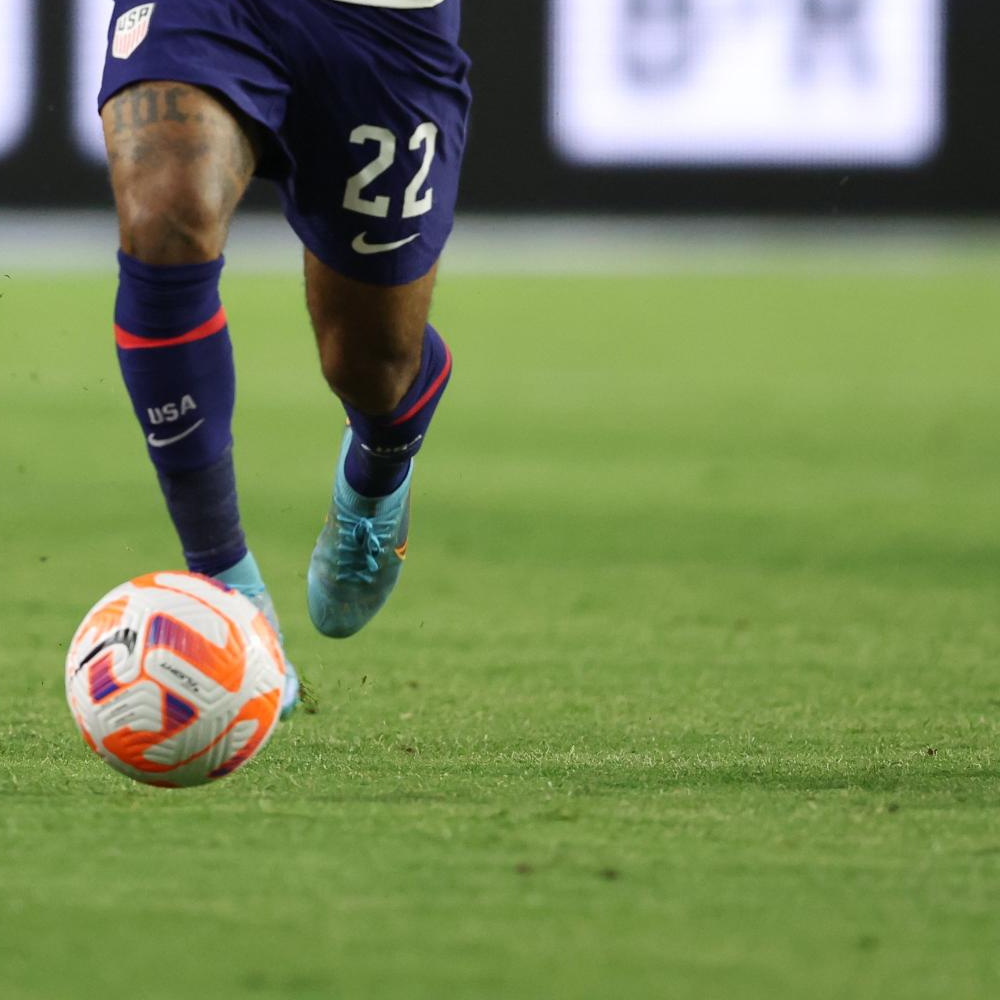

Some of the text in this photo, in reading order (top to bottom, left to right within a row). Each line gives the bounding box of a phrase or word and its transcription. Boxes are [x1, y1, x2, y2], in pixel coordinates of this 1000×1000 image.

[118, 7, 149, 31] USA
[343, 121, 438, 218] 22
[147, 394, 197, 425] USA
